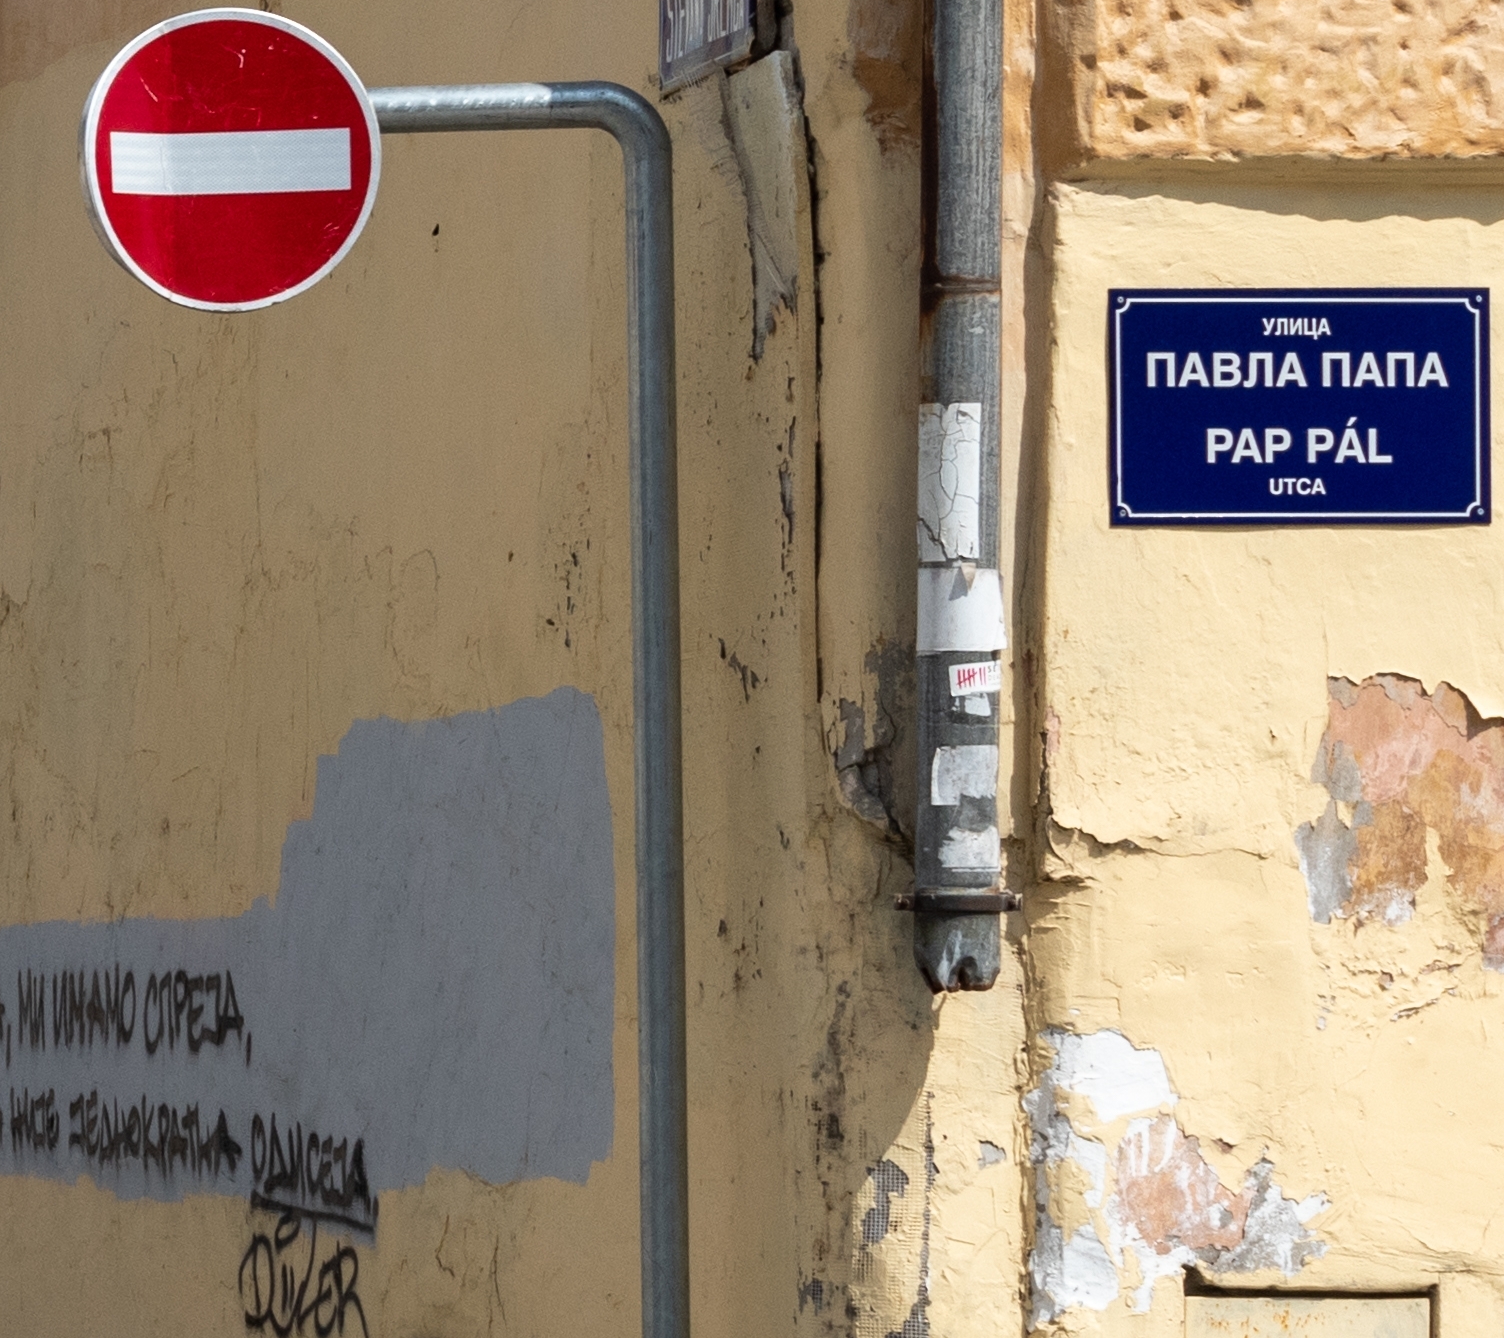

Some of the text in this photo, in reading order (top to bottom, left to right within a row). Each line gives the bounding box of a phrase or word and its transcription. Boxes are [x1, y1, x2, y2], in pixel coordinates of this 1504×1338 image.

[1263, 318, 1331, 339] УЛИЦА
[1146, 352, 1449, 387] ПАВЛА ПАПА
[1206, 417, 1392, 463] PAP PÁL
[1269, 478, 1326, 495] UTCA
[18, 968, 45, 1051] МИ
[52, 963, 136, 1049] ИМАМО
